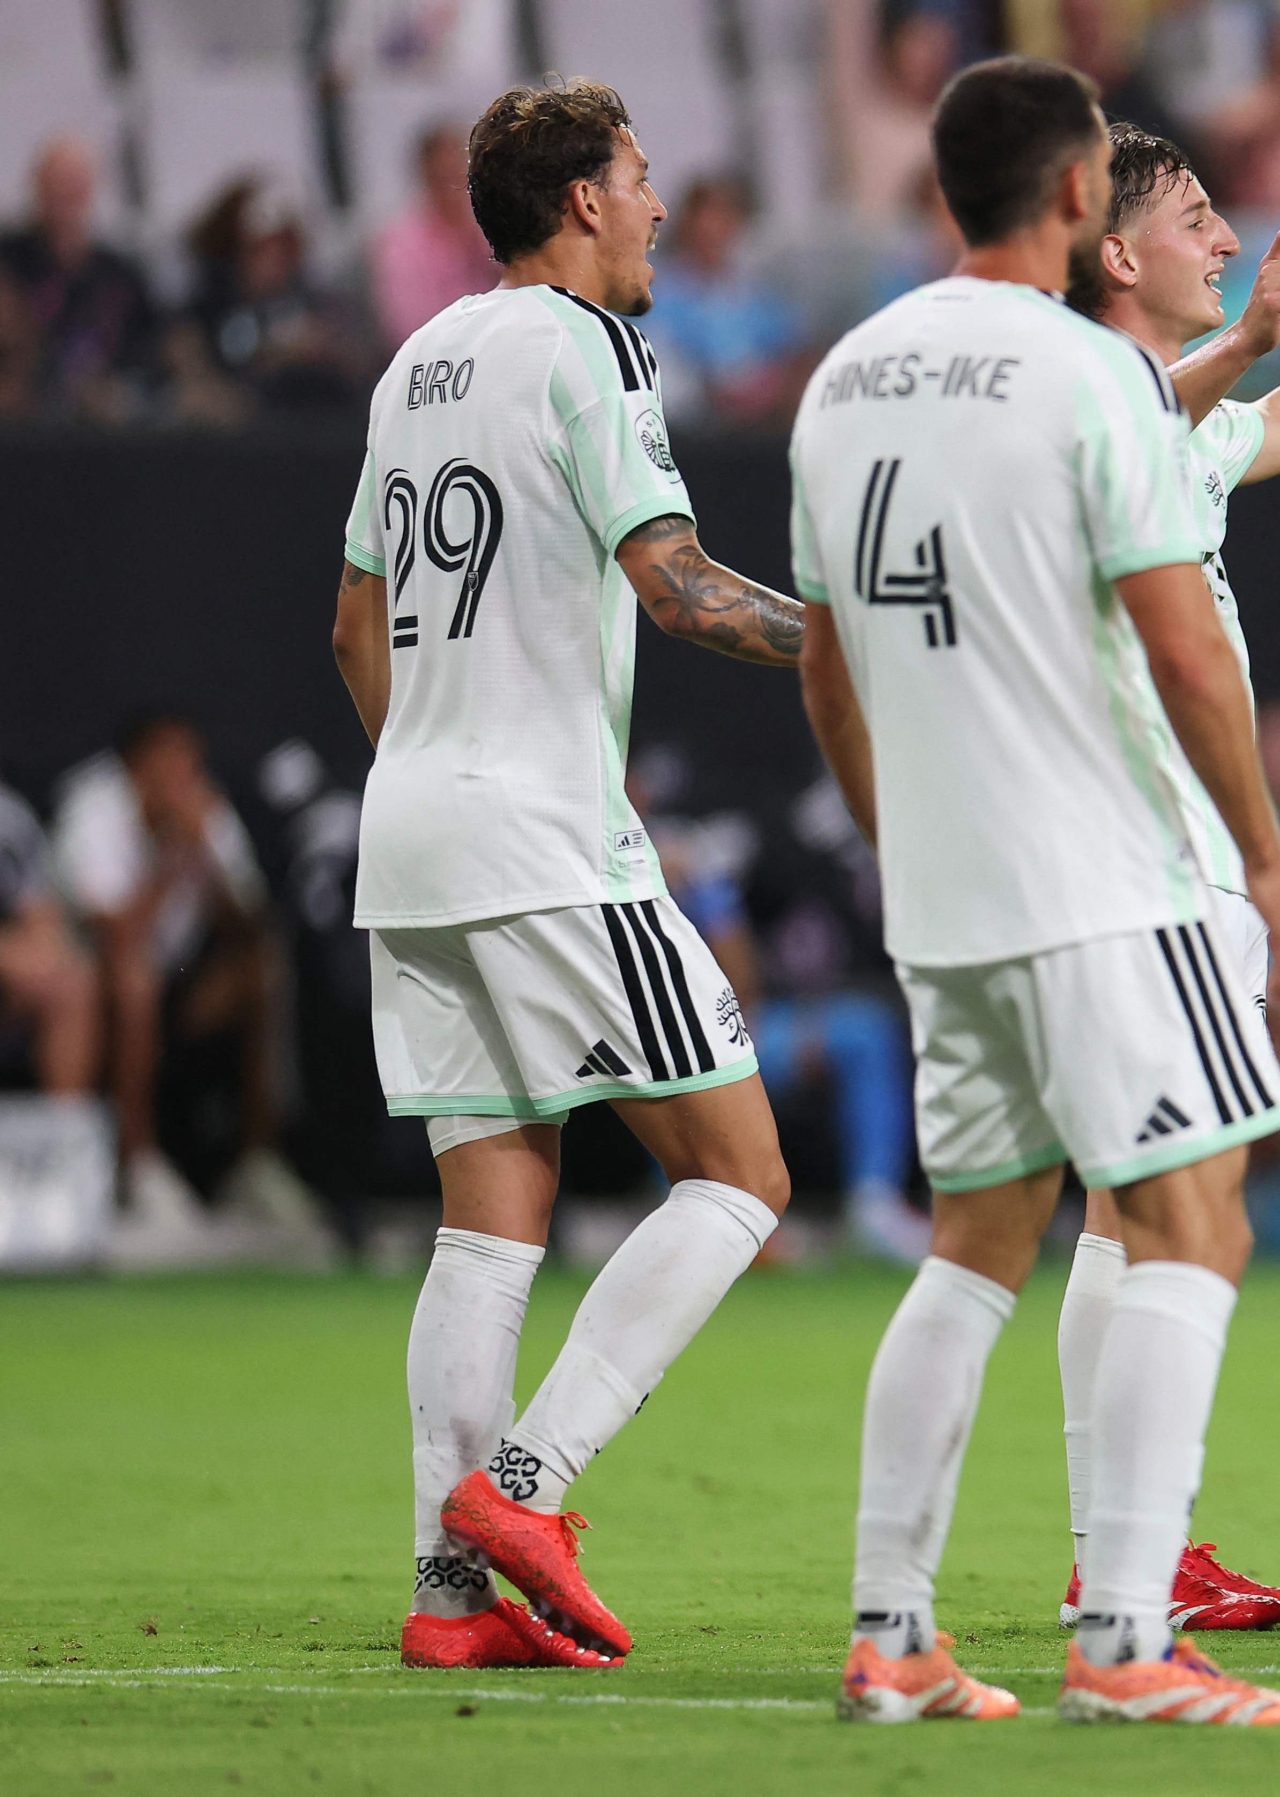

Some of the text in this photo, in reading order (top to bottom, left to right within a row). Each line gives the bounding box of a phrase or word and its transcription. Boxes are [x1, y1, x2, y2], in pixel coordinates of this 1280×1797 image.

[407, 357, 475, 411] BIRO
[819, 352, 1020, 409] HINES-IKE
[385, 457, 503, 649] 29
[854, 458, 957, 649] 4
